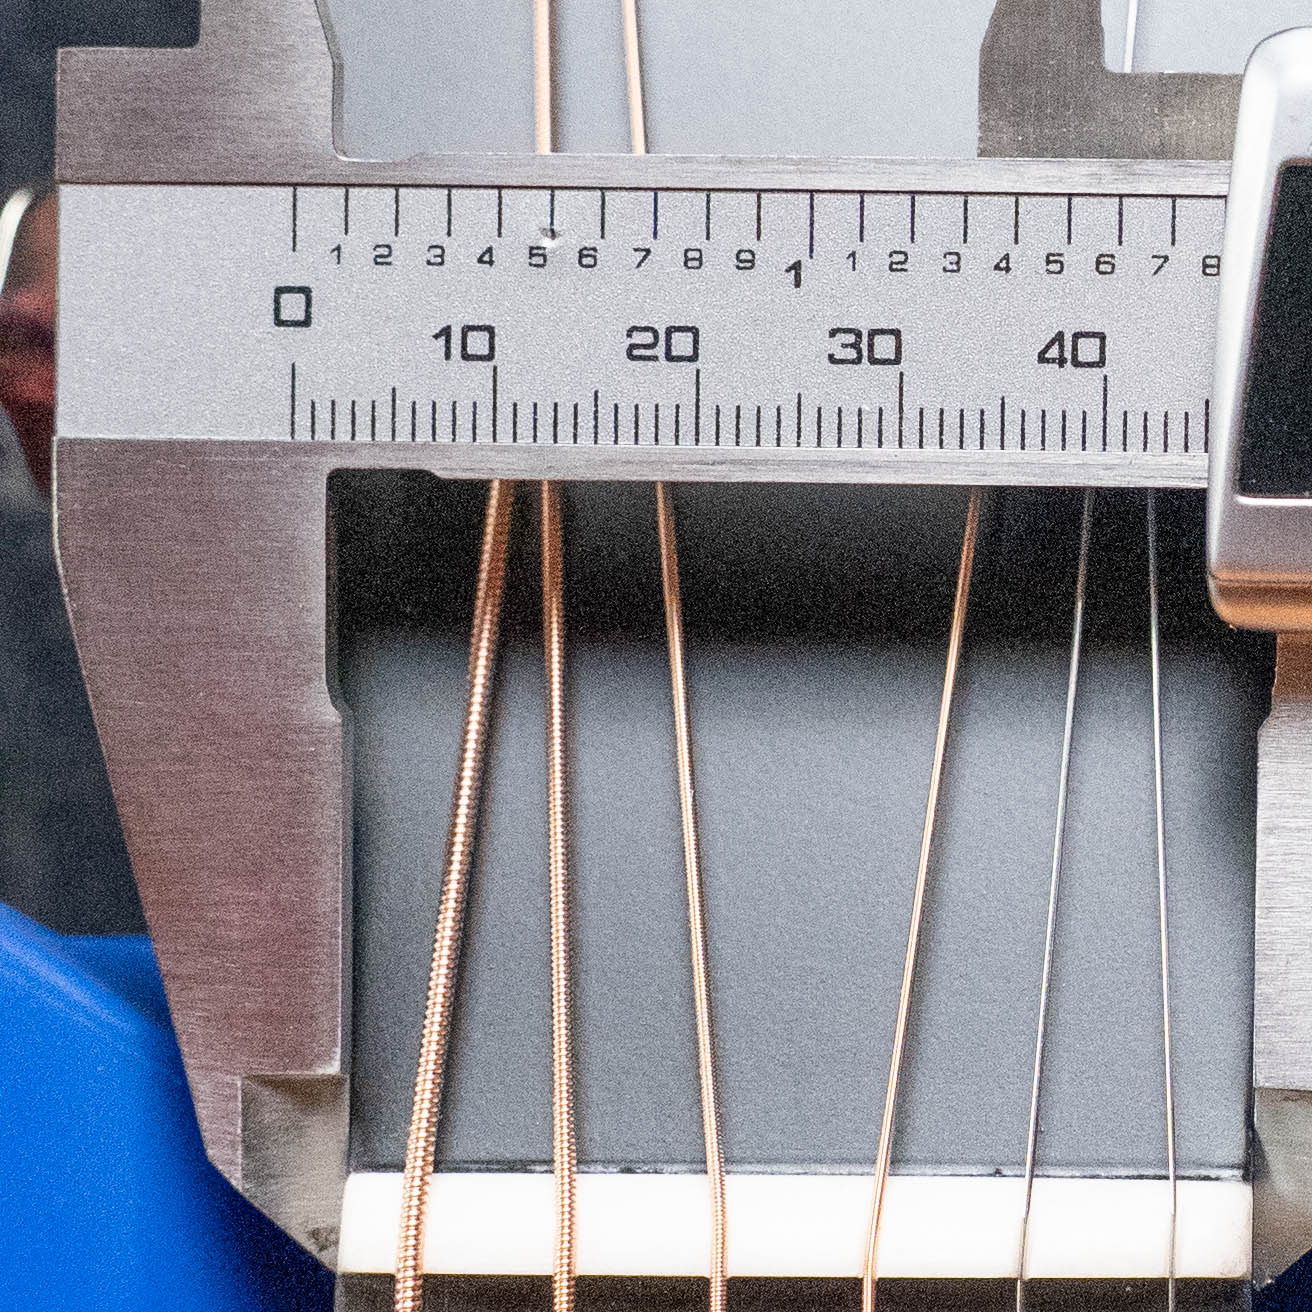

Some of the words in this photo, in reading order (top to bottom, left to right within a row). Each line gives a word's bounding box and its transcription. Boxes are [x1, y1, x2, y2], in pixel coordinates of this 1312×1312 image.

[331, 243, 343, 265] 1
[372, 243, 394, 266] 2
[425, 244, 446, 267] 3
[476, 245, 496, 267] 4
[528, 245, 548, 269] 5
[577, 246, 598, 269] 6
[632, 247, 653, 270] 7
[683, 248, 704, 271] 8
[734, 249, 756, 272] 9
[784, 258, 802, 289] 1
[845, 250, 857, 272] 1
[888, 250, 909, 274] 2
[942, 251, 962, 274] 3
[992, 252, 1013, 275] 4
[1045, 252, 1066, 275] 5
[1095, 253, 1116, 276] 6
[1150, 254, 1170, 276] 7
[1201, 254, 1222, 277] 8
[273, 285, 313, 328] 0
[431, 324, 497, 363] 10
[625, 325, 701, 363] 20
[827, 327, 903, 367] 30
[1036, 329, 1108, 369] 40
